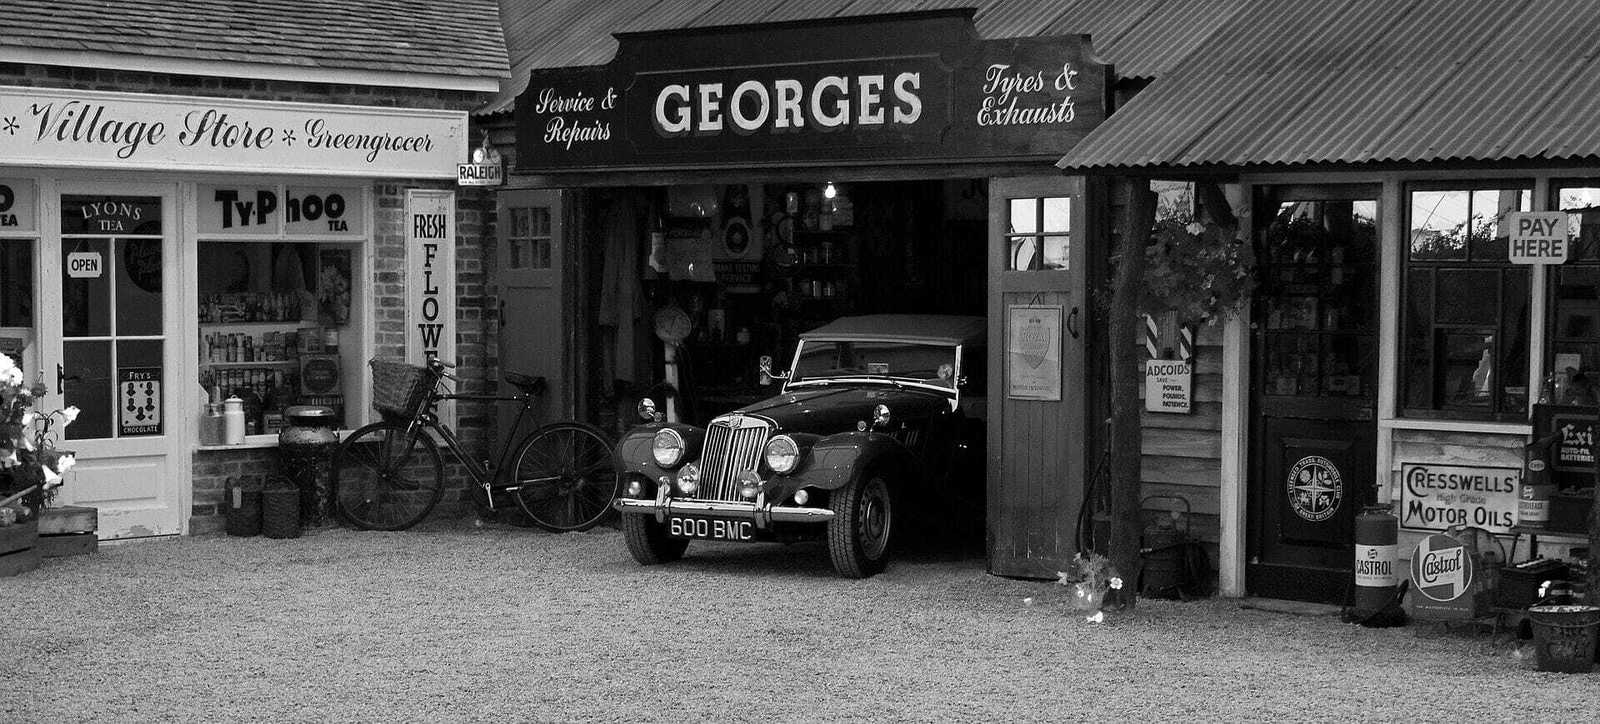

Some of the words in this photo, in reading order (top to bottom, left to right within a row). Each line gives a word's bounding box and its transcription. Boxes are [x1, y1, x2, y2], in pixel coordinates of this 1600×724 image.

[983, 64, 1043, 104] Tyres
[1055, 63, 1078, 90] &
[536, 88, 595, 114] Service
[601, 87, 617, 109] &
[655, 72, 923, 134] GEORGES
[977, 95, 1076, 127] Exhausts
[31, 101, 166, 159] Village
[180, 109, 273, 149] Store
[304, 118, 434, 163] Greengrocer
[544, 116, 611, 151] Repairs
[459, 165, 501, 179] RALEIGH
[0, 214, 18, 226] EA
[81, 201, 142, 221] LYONS
[98, 219, 124, 231] TEA
[328, 220, 348, 232] TEA
[414, 214, 446, 239] FRESH
[1519, 218, 1559, 237] PAY
[1513, 239, 1562, 258] HERE
[71, 258, 98, 272] OPEN
[1146, 364, 1190, 376] ADCOIDS
[123, 425, 158, 433] CHOCOLATE
[1561, 423, 1594, 446] Exi
[1405, 500, 1467, 526] MOTOR
[1474, 506, 1513, 527] OILS
[671, 517, 708, 537] 600
[713, 519, 752, 540] BMC
[1422, 549, 1462, 583] Castrol
